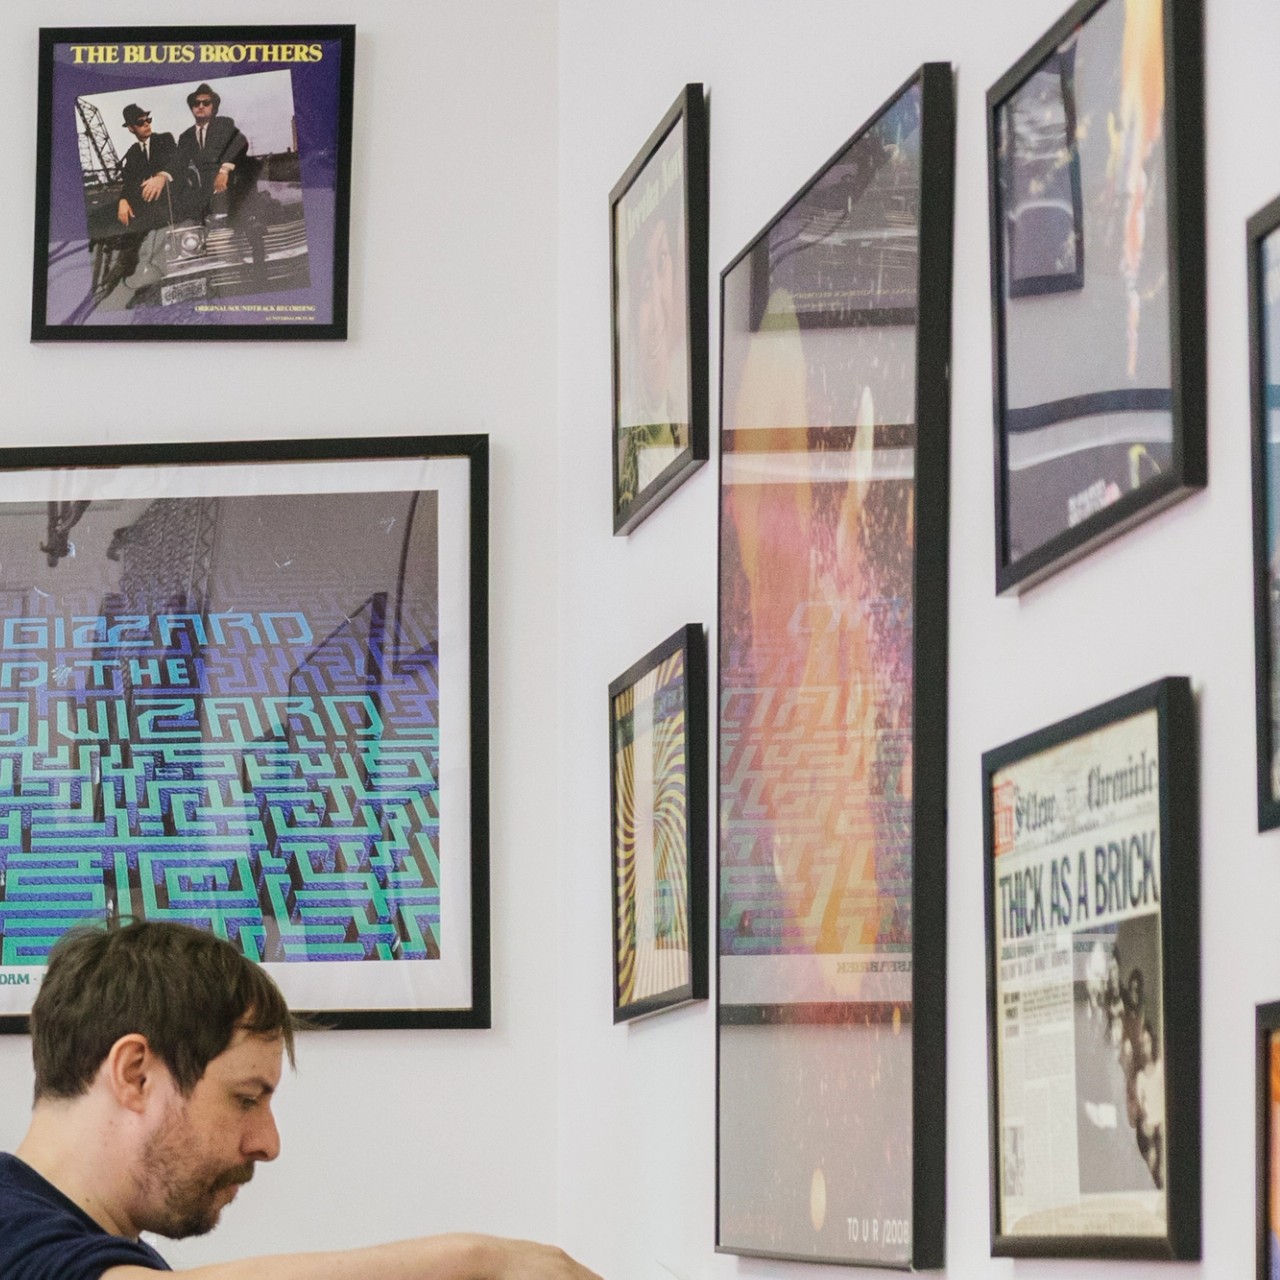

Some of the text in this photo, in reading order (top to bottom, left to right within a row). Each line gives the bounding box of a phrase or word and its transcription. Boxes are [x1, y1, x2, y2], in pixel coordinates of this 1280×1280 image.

[71, 43, 323, 64] THE BLUES BROTHERS
[72, 659, 190, 686] THE
[56, 694, 385, 742] WIZARD
[999, 829, 1160, 940] THICK AS A BRICK
